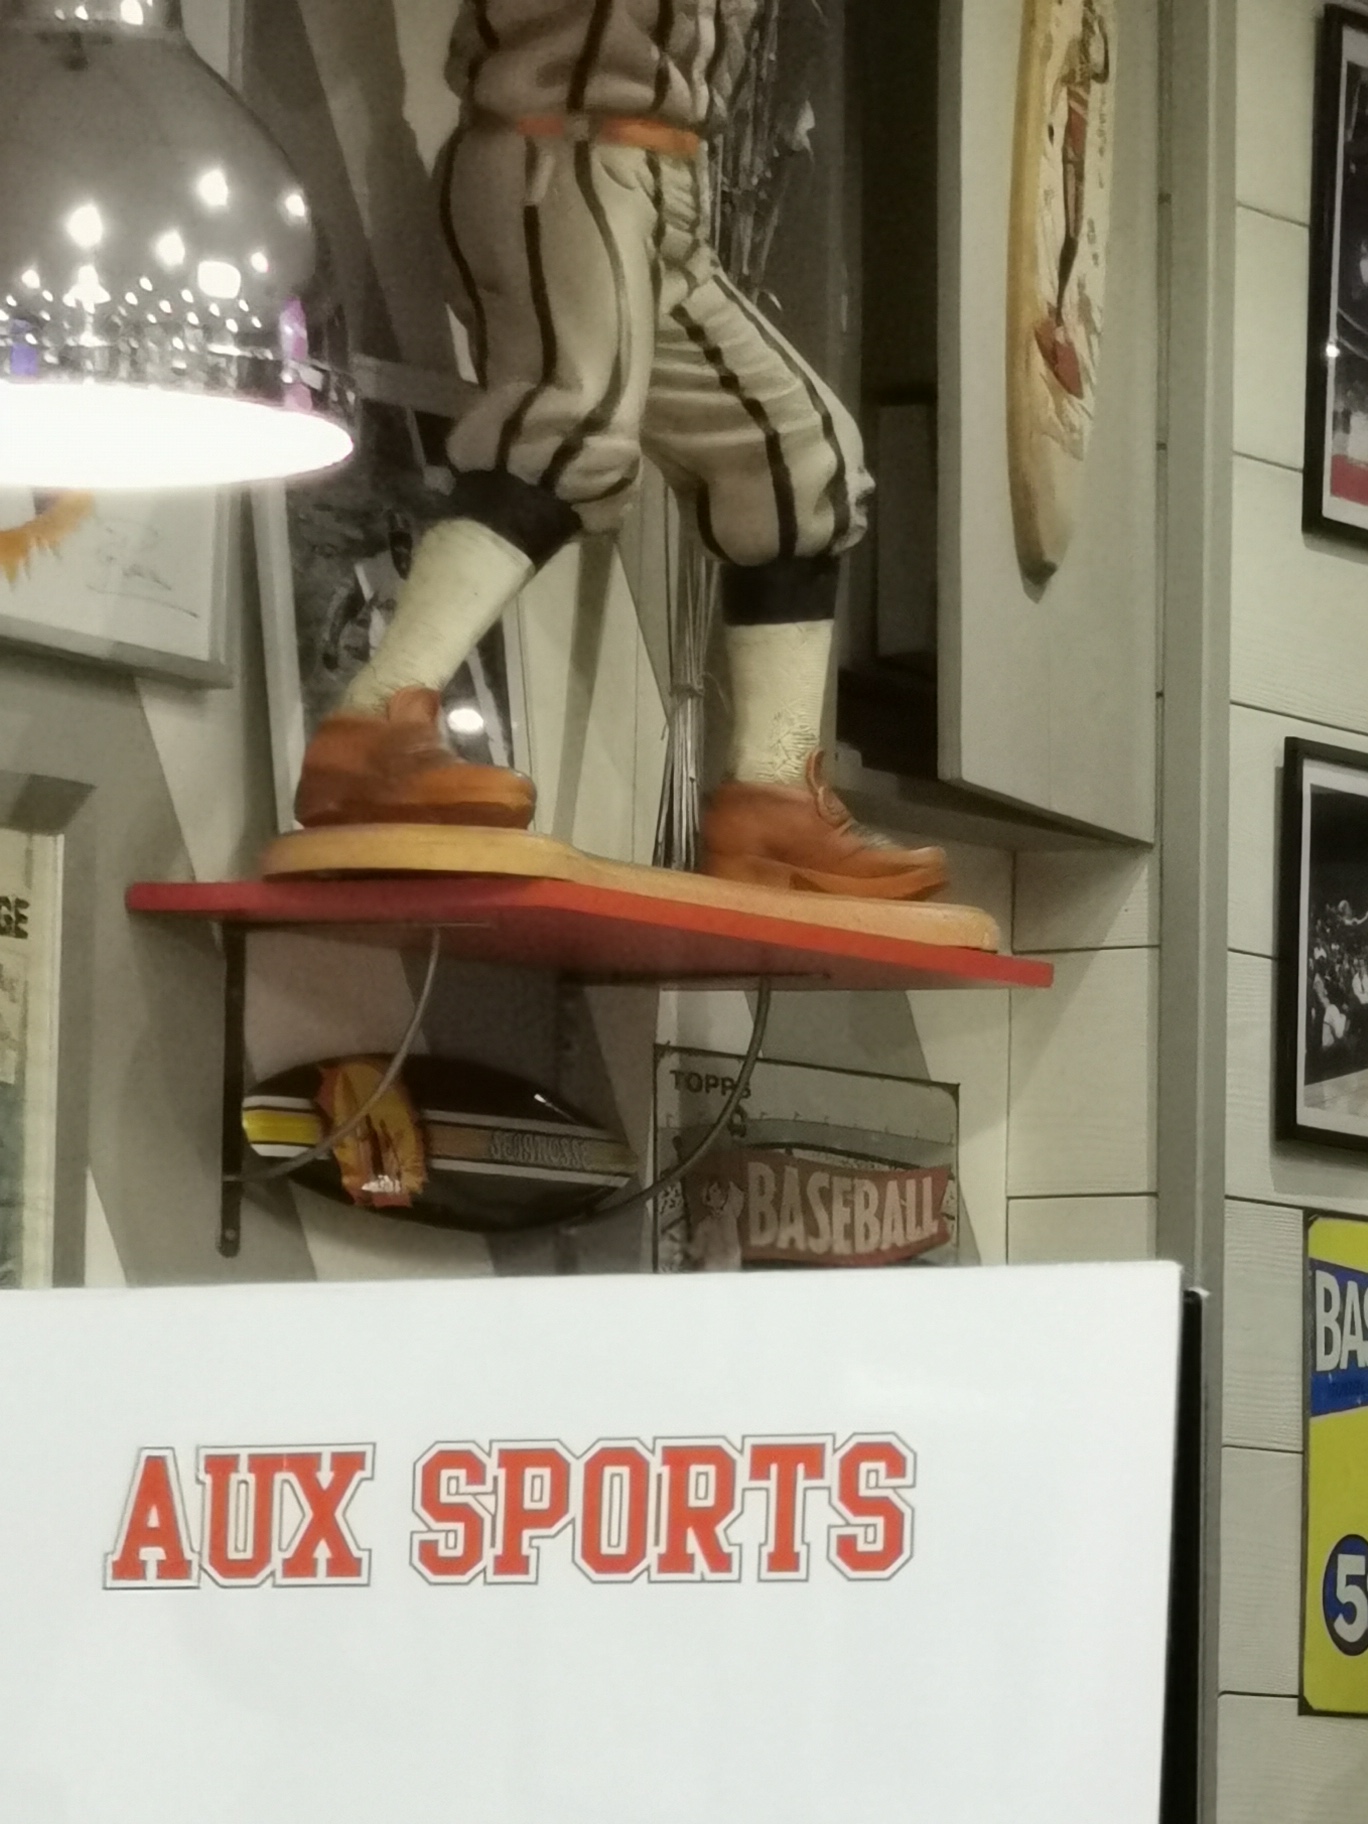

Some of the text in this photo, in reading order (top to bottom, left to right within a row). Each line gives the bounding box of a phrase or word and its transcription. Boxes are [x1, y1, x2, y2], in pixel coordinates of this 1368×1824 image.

[748, 1161, 941, 1255] BASEBALL
[102, 1431, 919, 1590] AUX SPORTS
